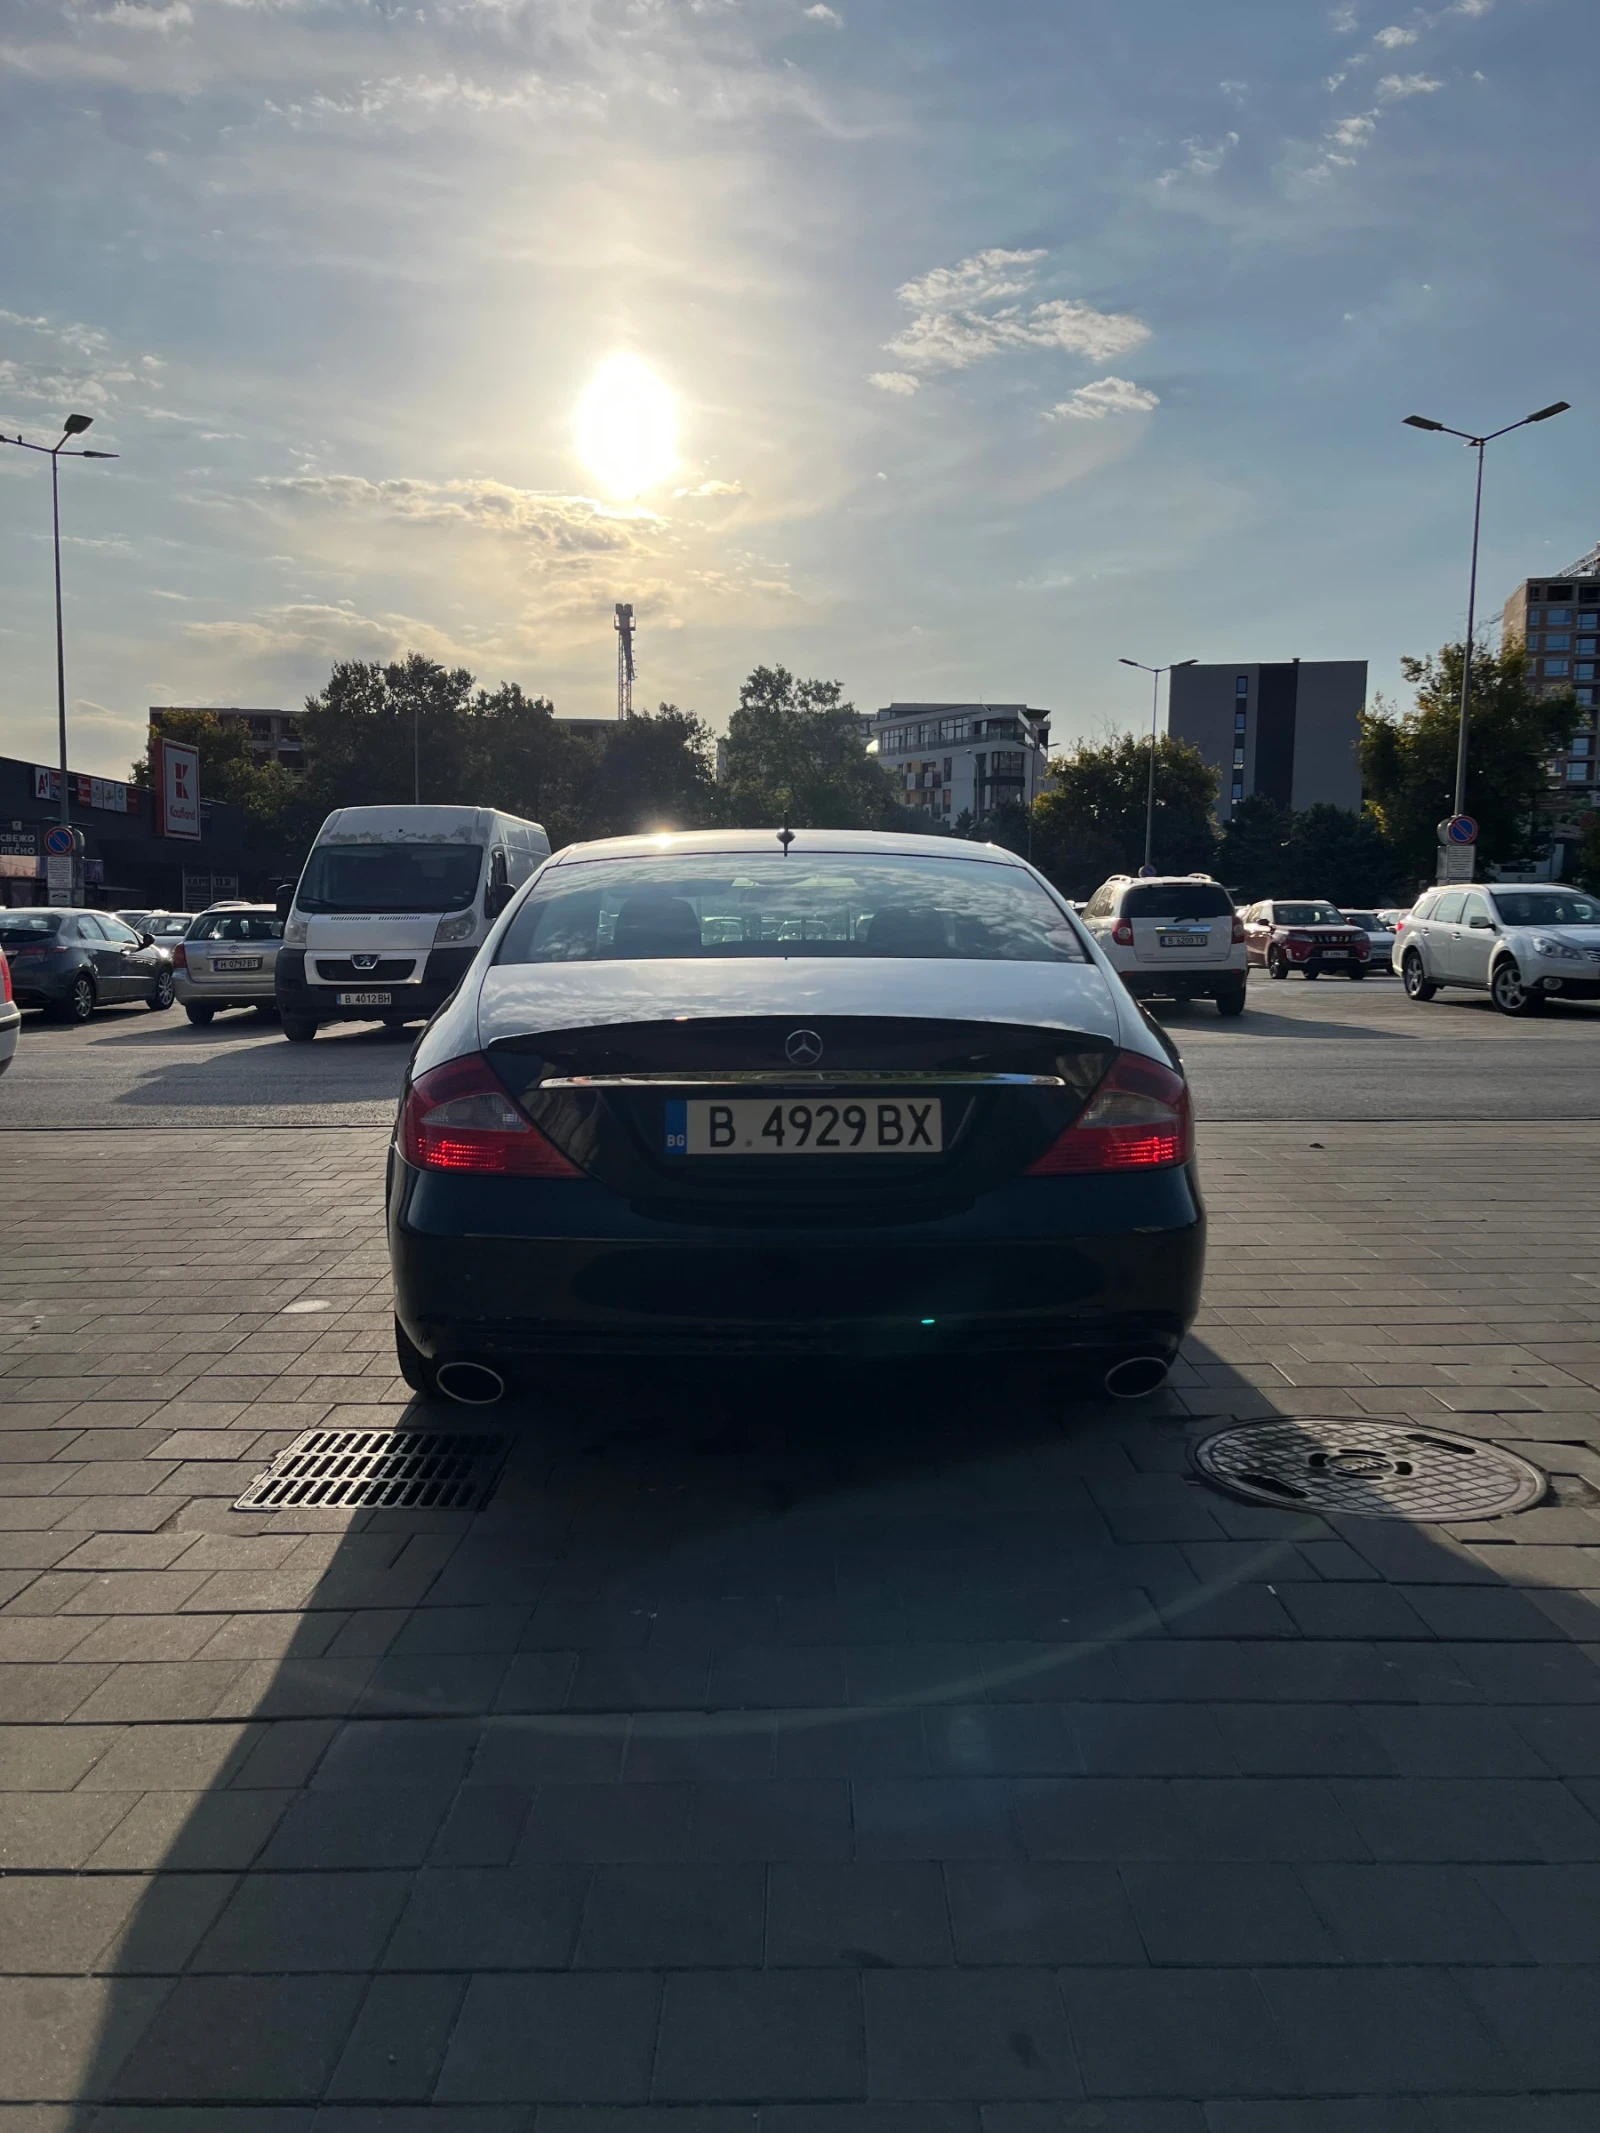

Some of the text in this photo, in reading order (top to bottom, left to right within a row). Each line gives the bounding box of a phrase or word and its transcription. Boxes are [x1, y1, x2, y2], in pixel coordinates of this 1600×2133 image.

[169, 805, 195, 821] Kaufland
[710, 1106, 736, 1147] B
[666, 1134, 685, 1147] BG
